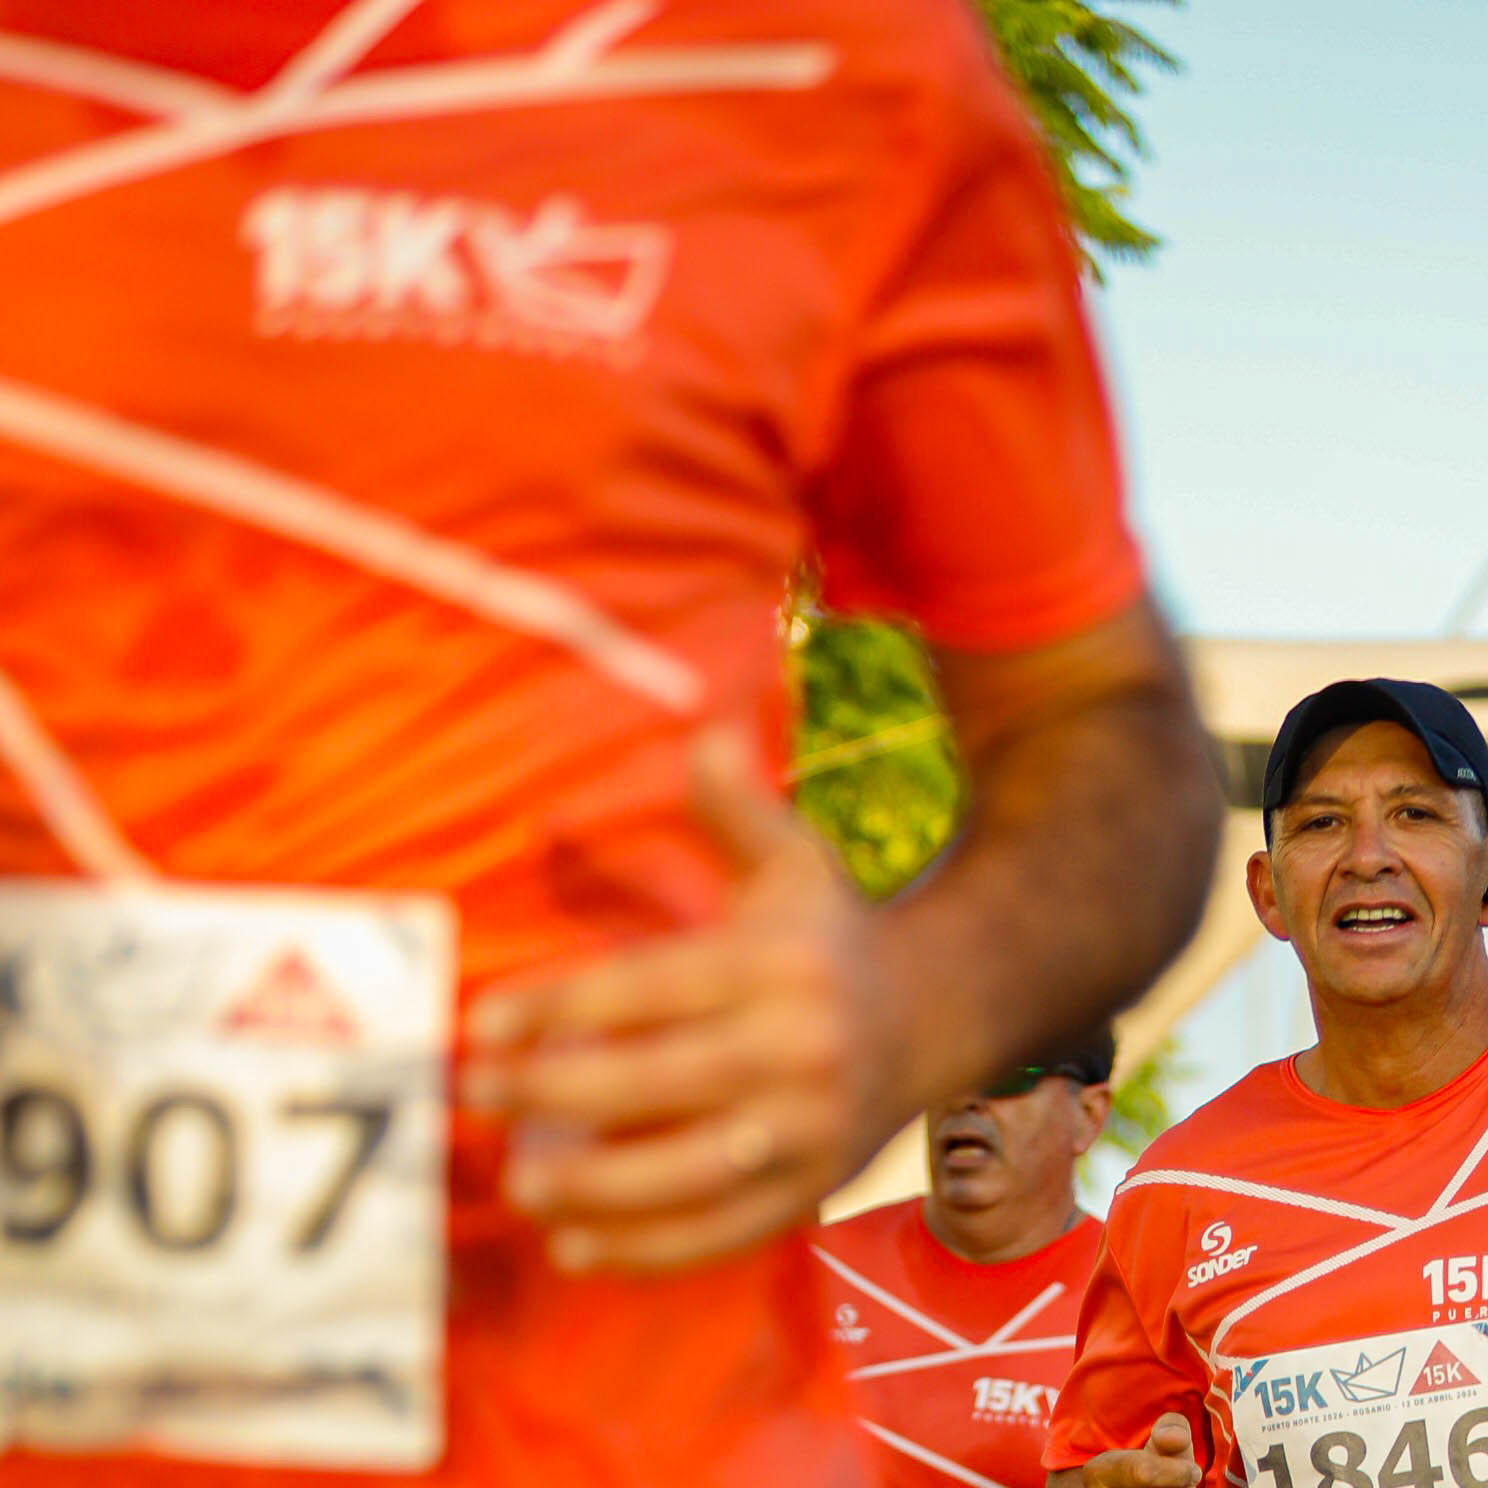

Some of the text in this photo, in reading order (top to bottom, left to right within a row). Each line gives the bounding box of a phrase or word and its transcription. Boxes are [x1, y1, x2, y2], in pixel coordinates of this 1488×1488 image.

[1423, 1361, 1463, 1387] 15K
[973, 1377, 1042, 1416] 15K
[1254, 1370, 1328, 1418] 15K
